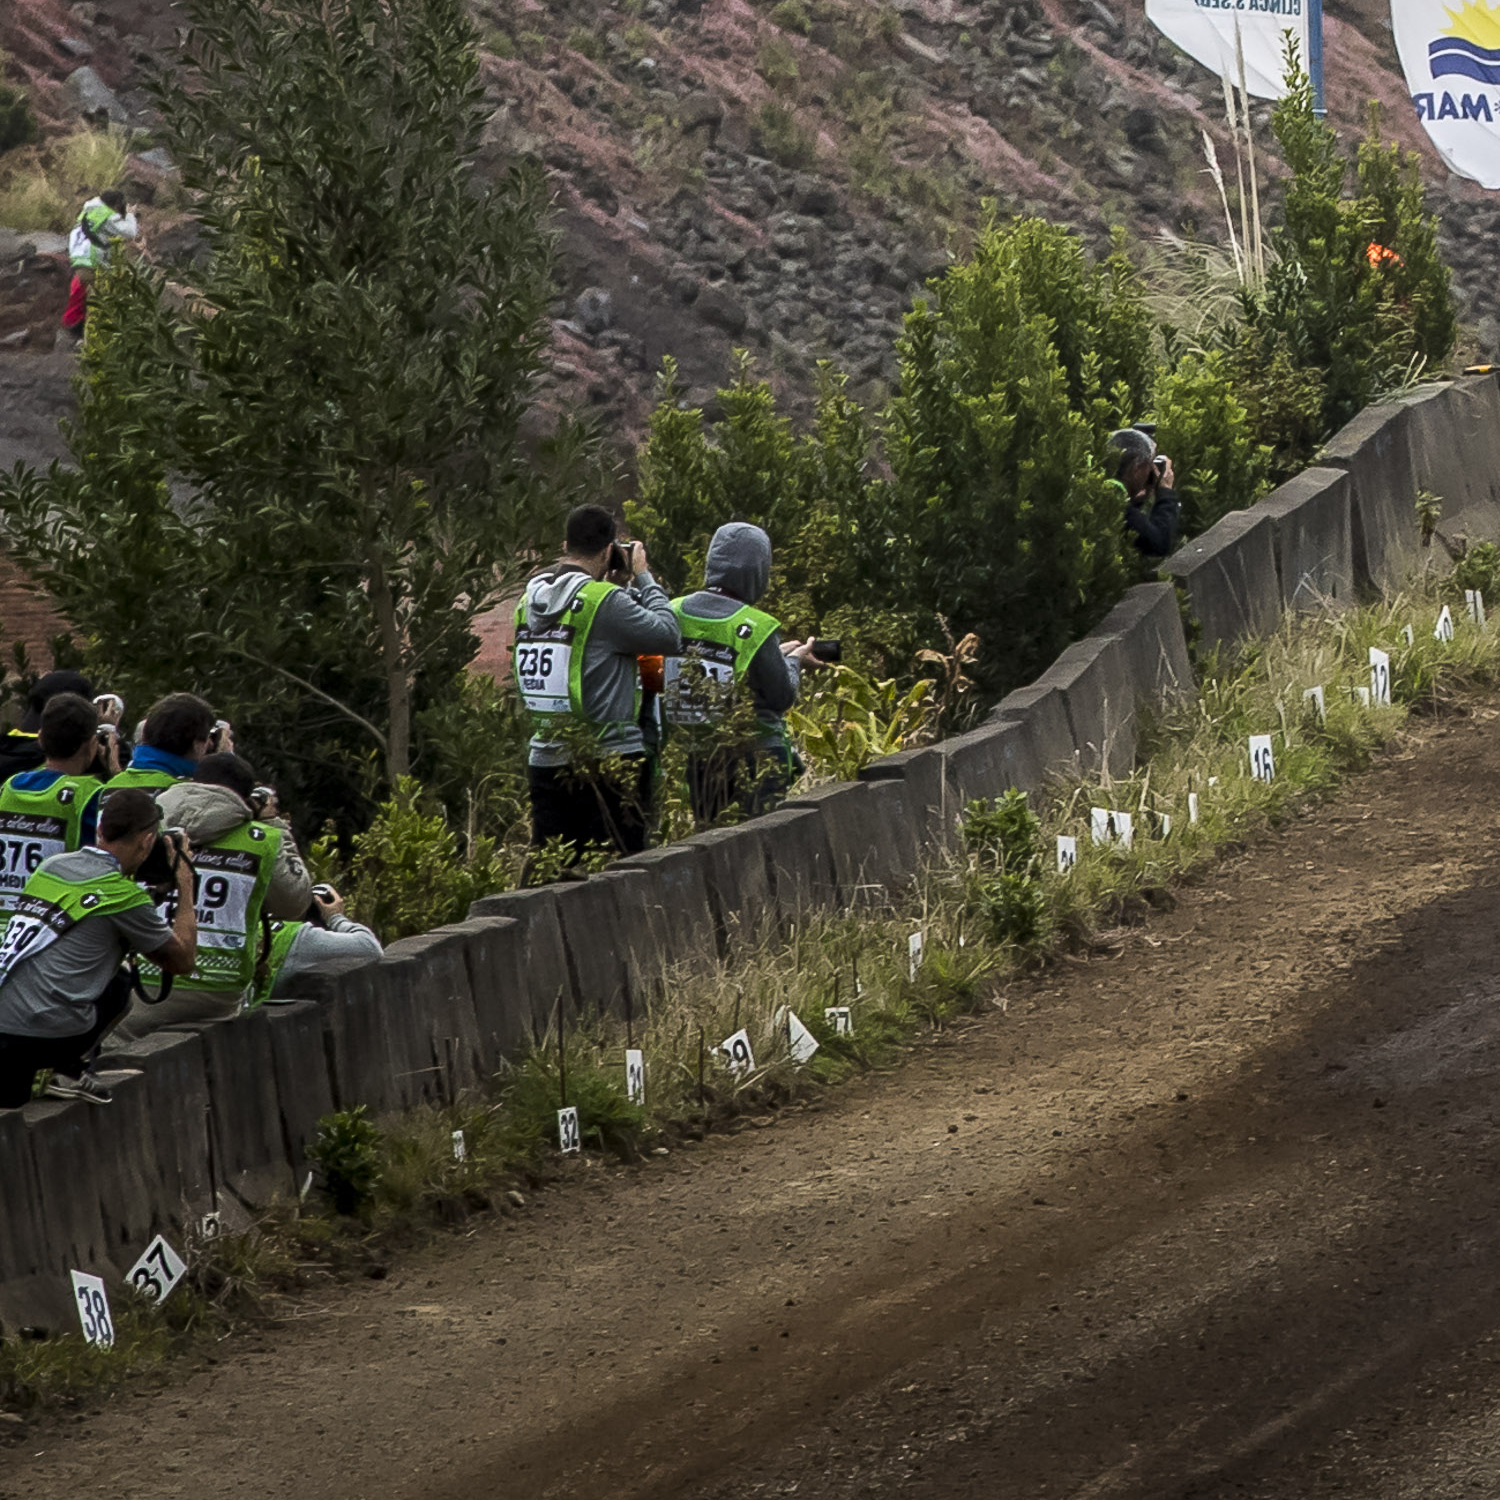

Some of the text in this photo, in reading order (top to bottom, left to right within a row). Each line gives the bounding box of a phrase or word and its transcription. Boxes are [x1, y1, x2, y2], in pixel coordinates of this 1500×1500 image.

[518, 647, 553, 678] 236
[1254, 747, 1273, 784] 16
[0, 873, 27, 889] MEDI
[77, 1286, 112, 1343] 38
